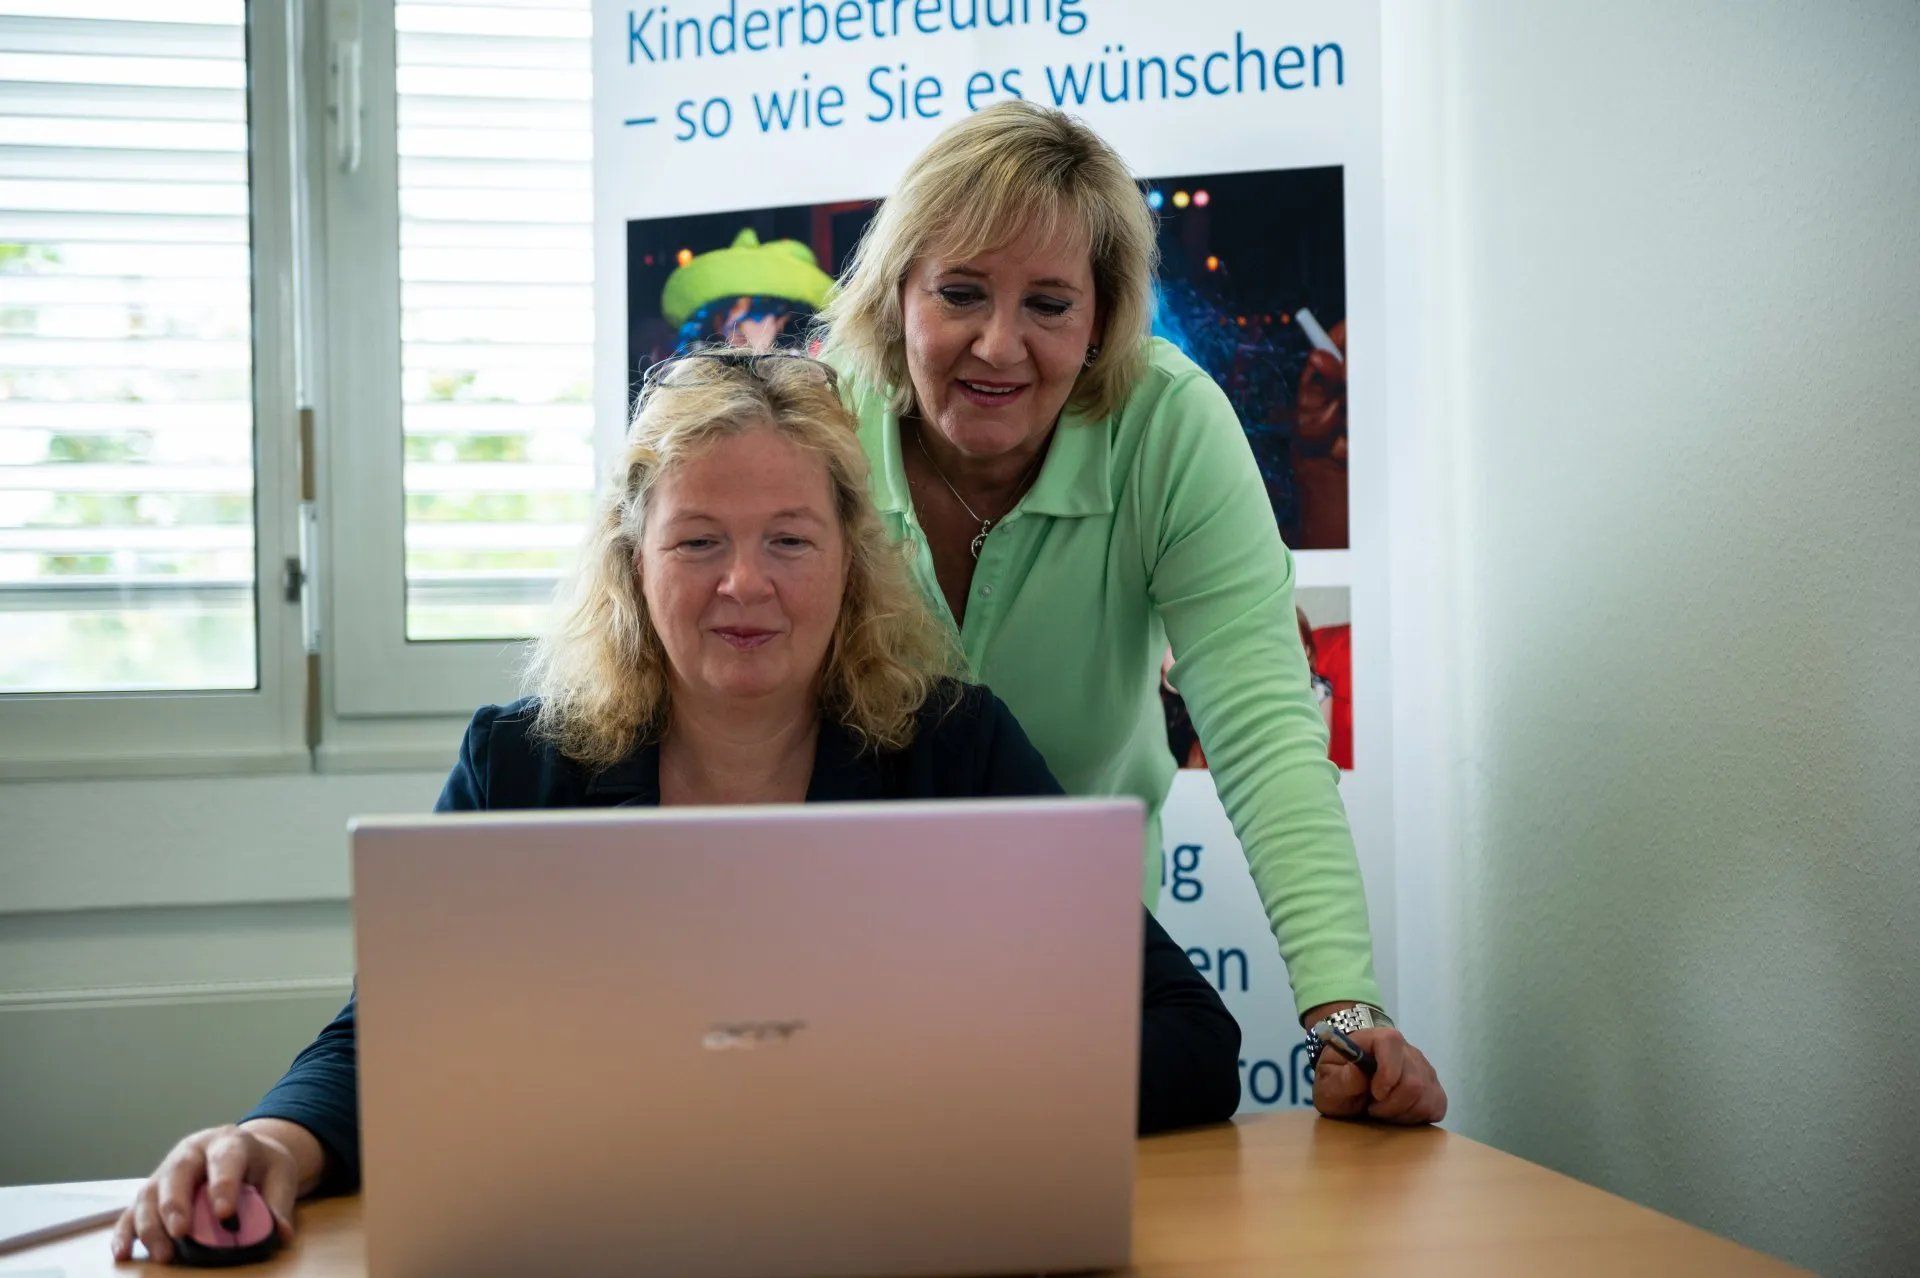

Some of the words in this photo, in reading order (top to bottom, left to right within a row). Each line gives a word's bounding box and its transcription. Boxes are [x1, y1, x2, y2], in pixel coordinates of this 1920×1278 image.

[675, 97, 732, 142] so
[752, 72, 845, 133] wie
[866, 63, 943, 122] Sie
[1045, 31, 1345, 107] wünschen
